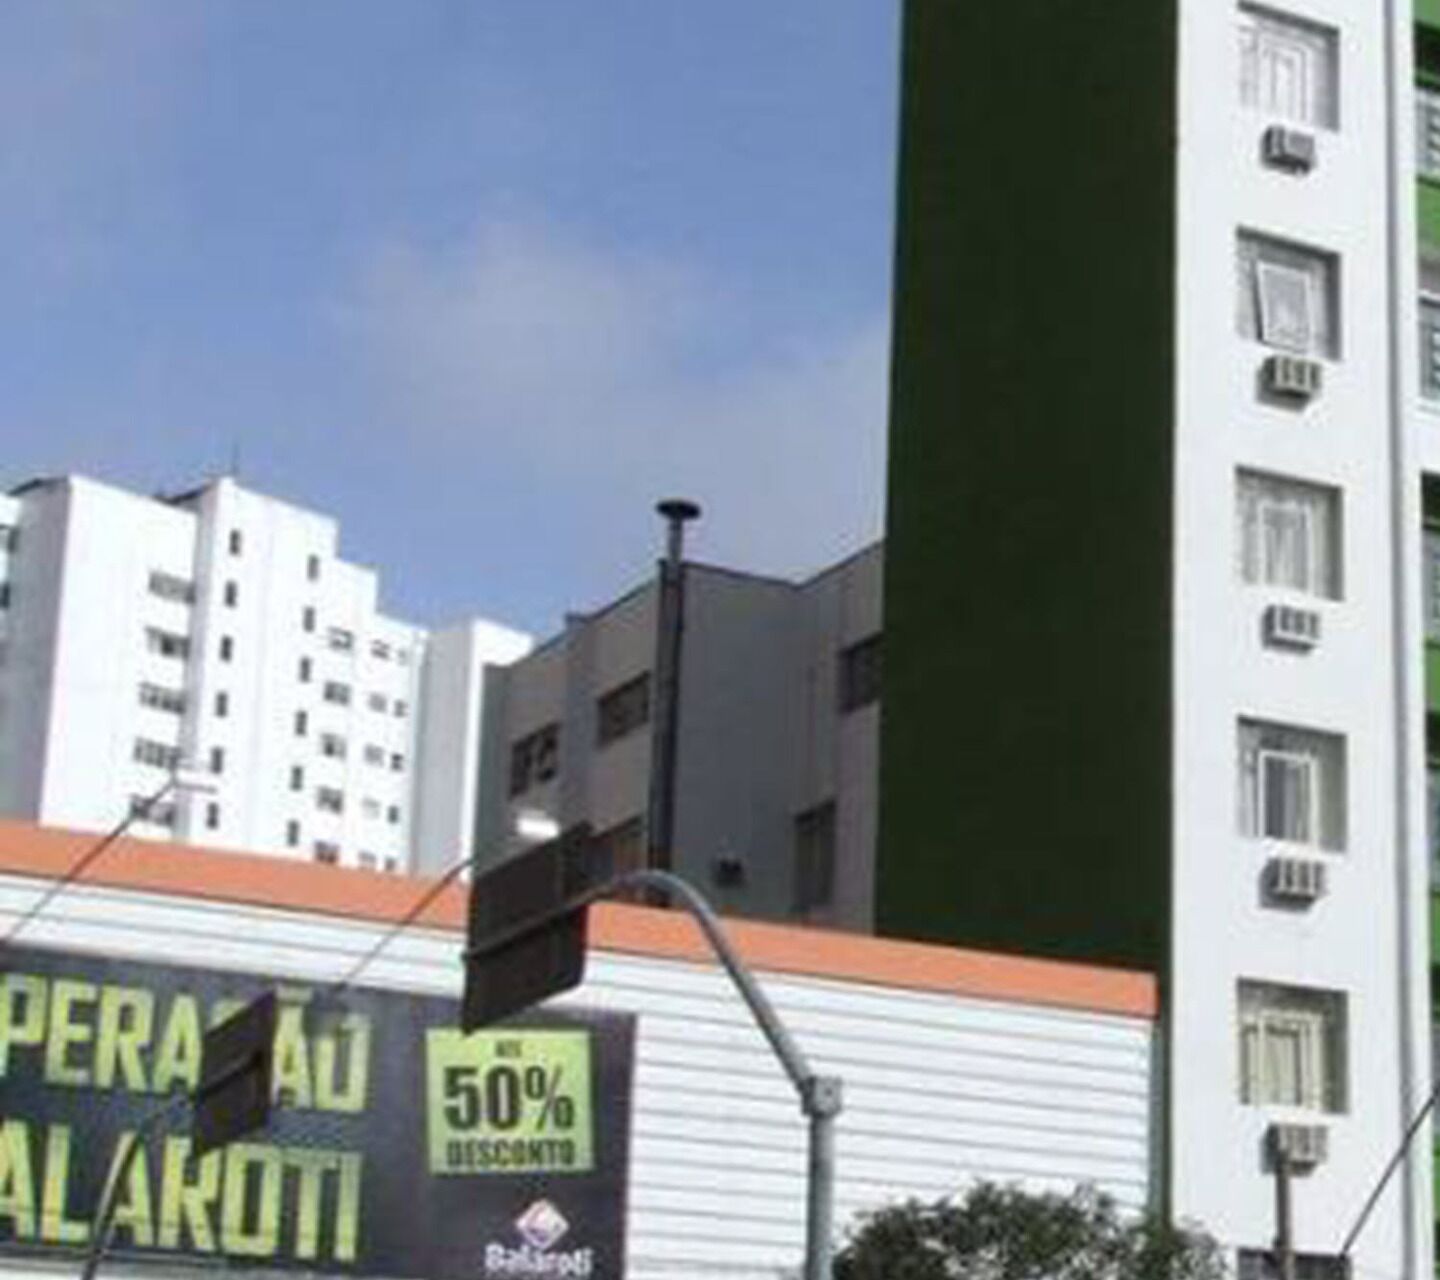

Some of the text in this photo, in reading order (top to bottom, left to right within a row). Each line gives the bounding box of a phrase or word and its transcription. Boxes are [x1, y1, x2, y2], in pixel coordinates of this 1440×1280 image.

[0, 973, 372, 1112] PERAÃO
[443, 1065, 575, 1131] 50%
[446, 1138, 576, 1167] DESCONTO
[484, 1242, 594, 1277] Balaroti
